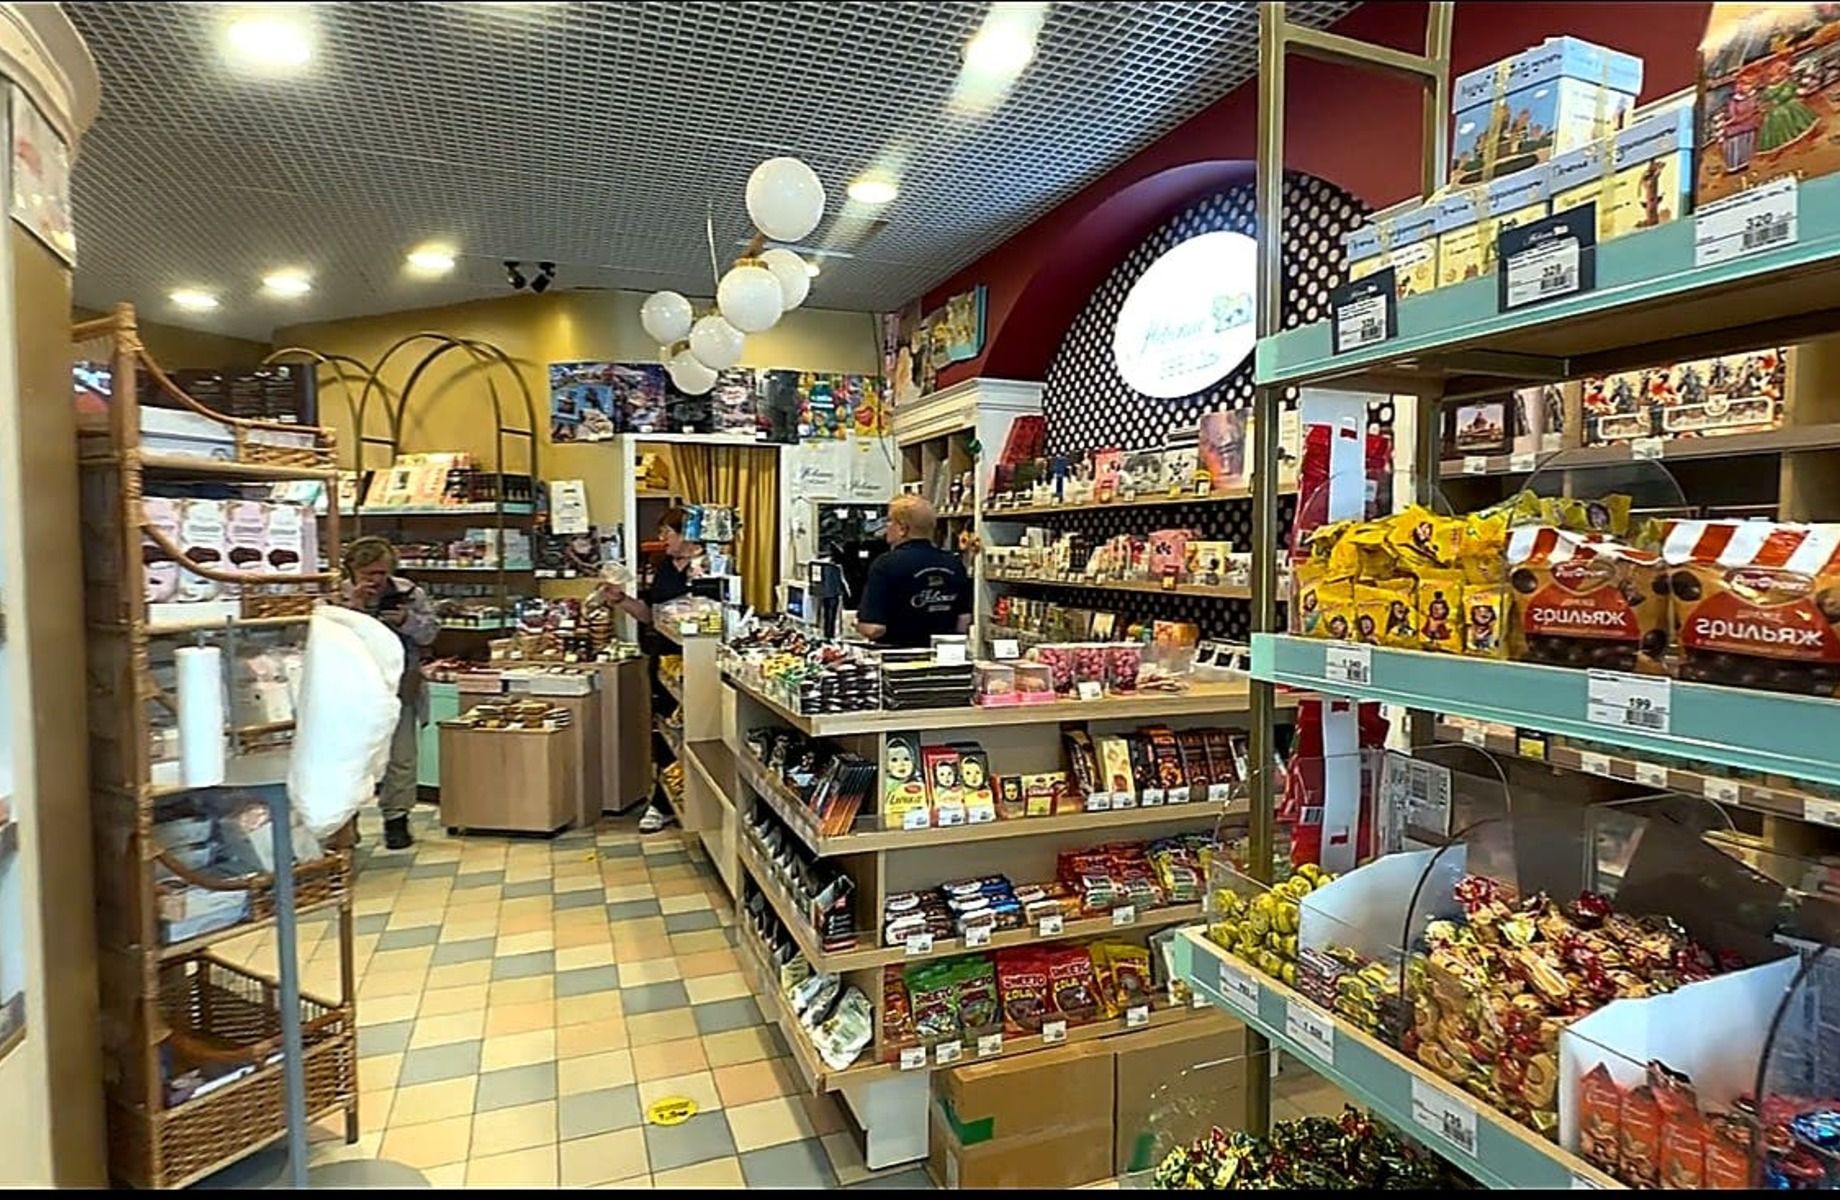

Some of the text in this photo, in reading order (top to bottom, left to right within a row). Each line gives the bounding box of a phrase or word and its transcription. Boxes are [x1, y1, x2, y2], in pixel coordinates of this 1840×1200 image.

[1745, 211, 1773, 231] 320
[1533, 607, 1627, 626] грильяж
[1695, 617, 1824, 647] грильяж
[1629, 697, 1651, 710] 199
[1055, 977, 1080, 992] COLA
[1005, 987, 1035, 1001] COLA
